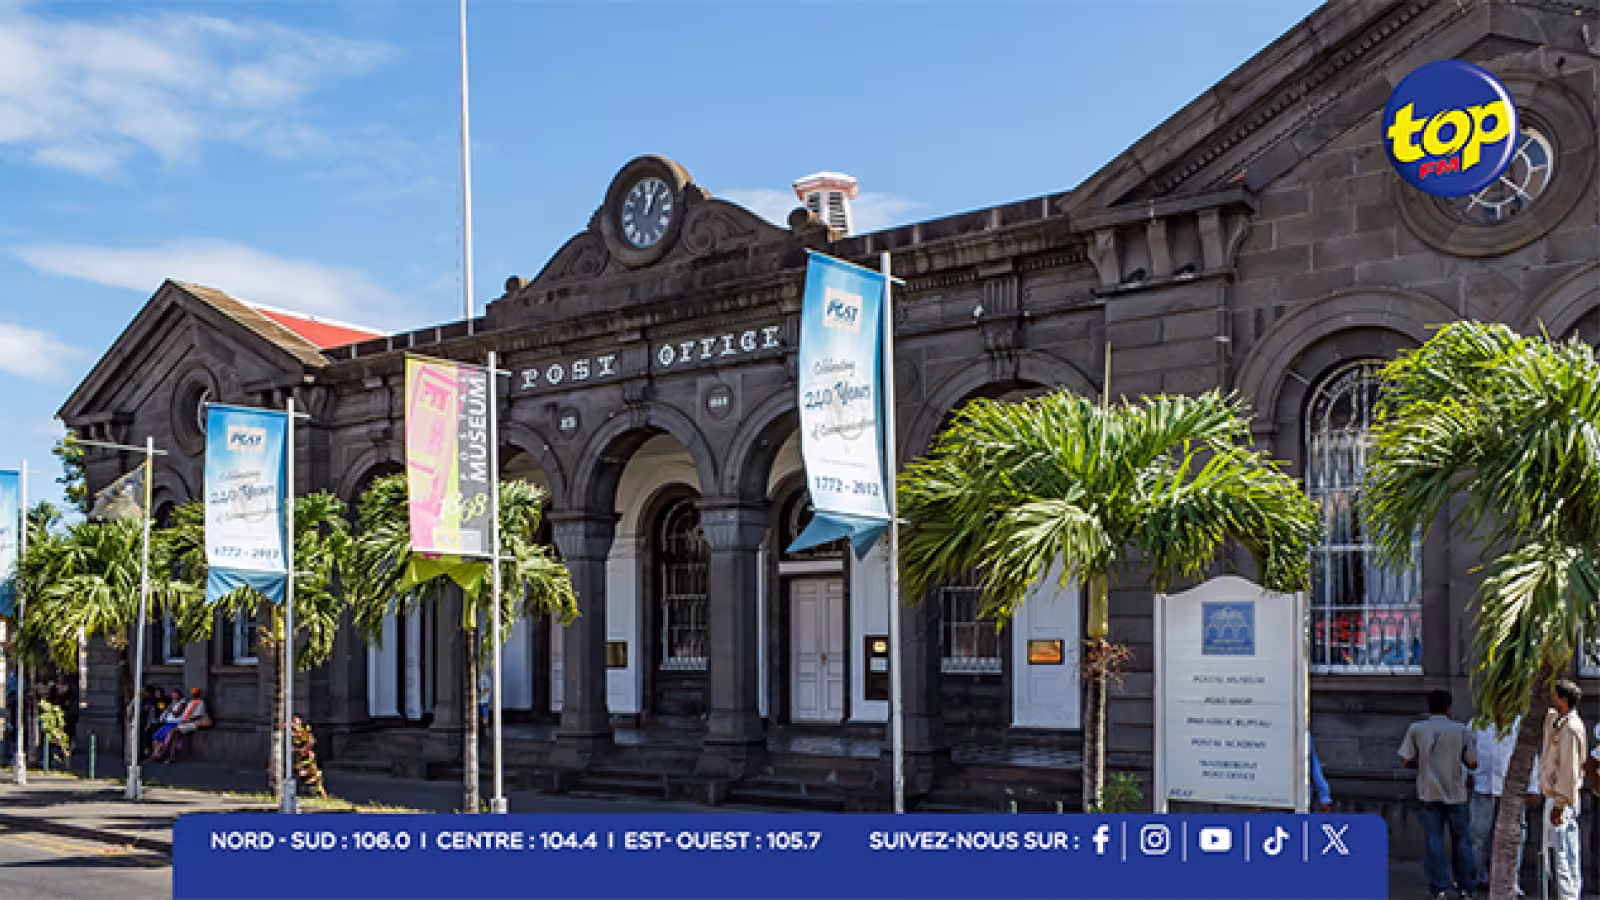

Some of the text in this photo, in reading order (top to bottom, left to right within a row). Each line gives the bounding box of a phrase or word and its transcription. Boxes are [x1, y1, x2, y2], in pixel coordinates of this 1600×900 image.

[520, 325, 781, 390] POST OFFICE
[468, 377, 487, 484] MUSEUM
